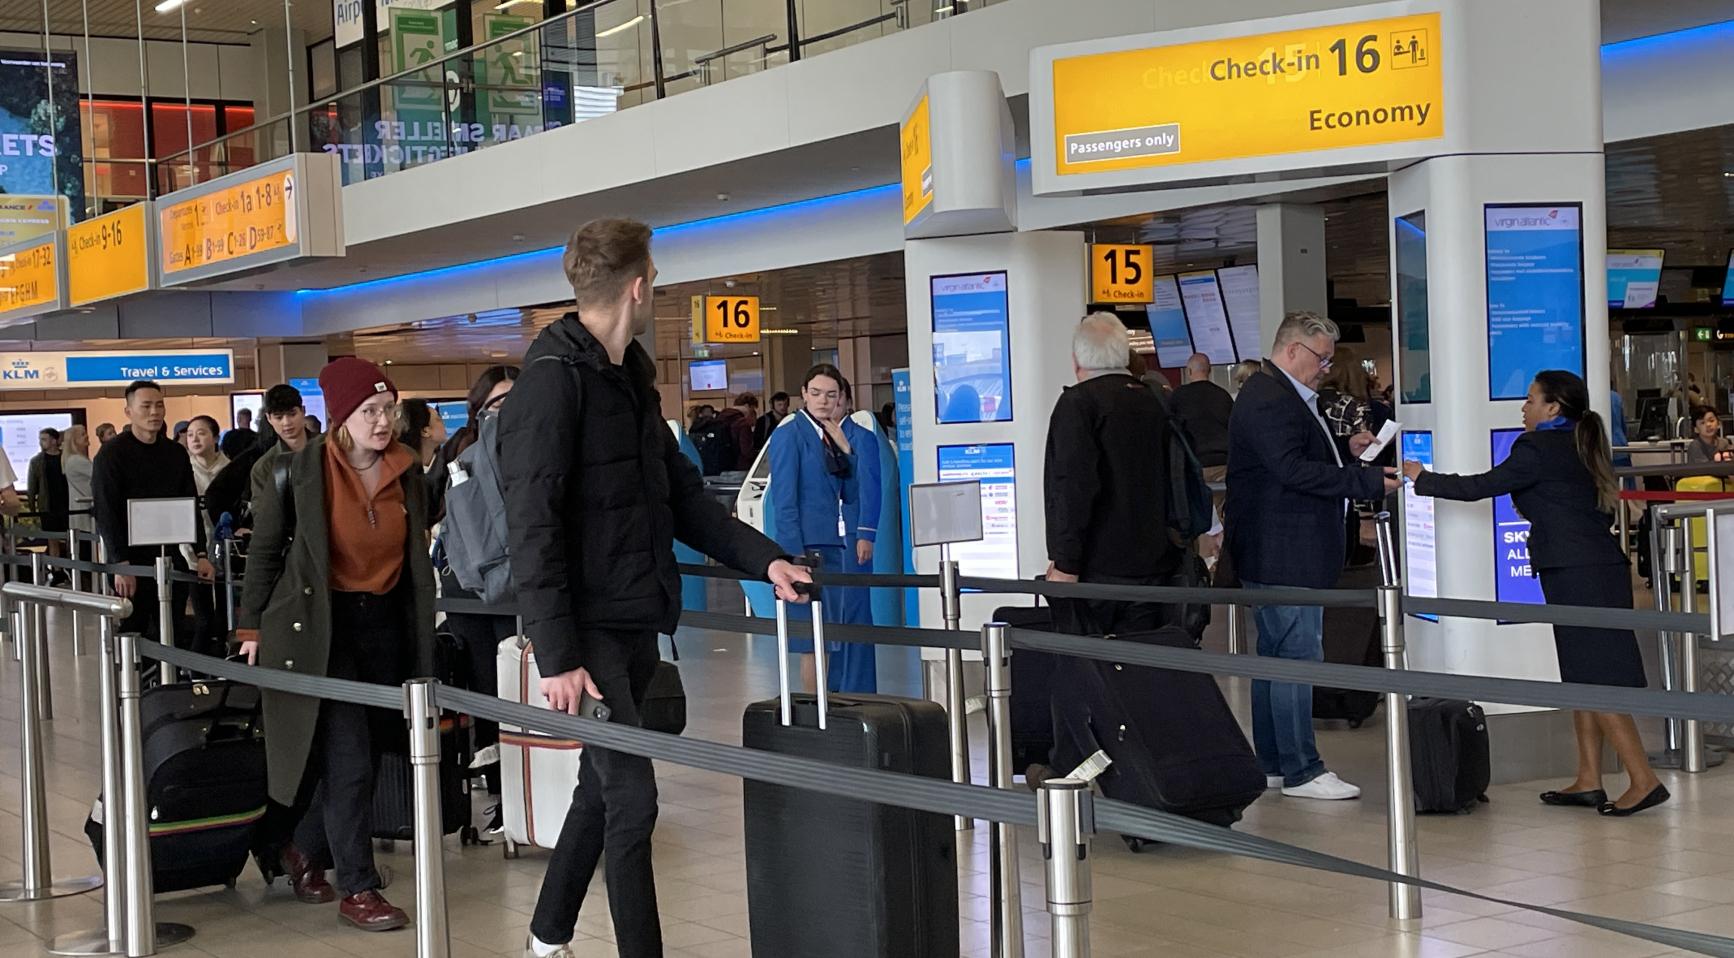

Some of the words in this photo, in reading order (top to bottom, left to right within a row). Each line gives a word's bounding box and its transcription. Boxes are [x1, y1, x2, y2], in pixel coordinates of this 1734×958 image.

[336, 1, 363, 26] Airp
[1210, 49, 1320, 81] Check-in
[1329, 34, 1381, 76] 16
[1309, 102, 1431, 131] Economy
[0, 133, 57, 157] ETS
[1070, 138, 1141, 155] Passengers
[1145, 132, 1175, 147] only
[215, 198, 239, 215] Check-in
[240, 190, 253, 214] 1a
[255, 183, 272, 210] 1-8
[79, 232, 101, 250] Check-in
[101, 219, 122, 250] 9-16
[1104, 249, 1142, 285] 15
[1113, 290, 1145, 299] Check-in
[716, 299, 750, 328] 16
[725, 331, 753, 339] Check-in
[3, 369, 39, 380] KLM
[121, 366, 158, 377] Travel
[162, 366, 170, 377] &
[174, 364, 223, 376] Services
